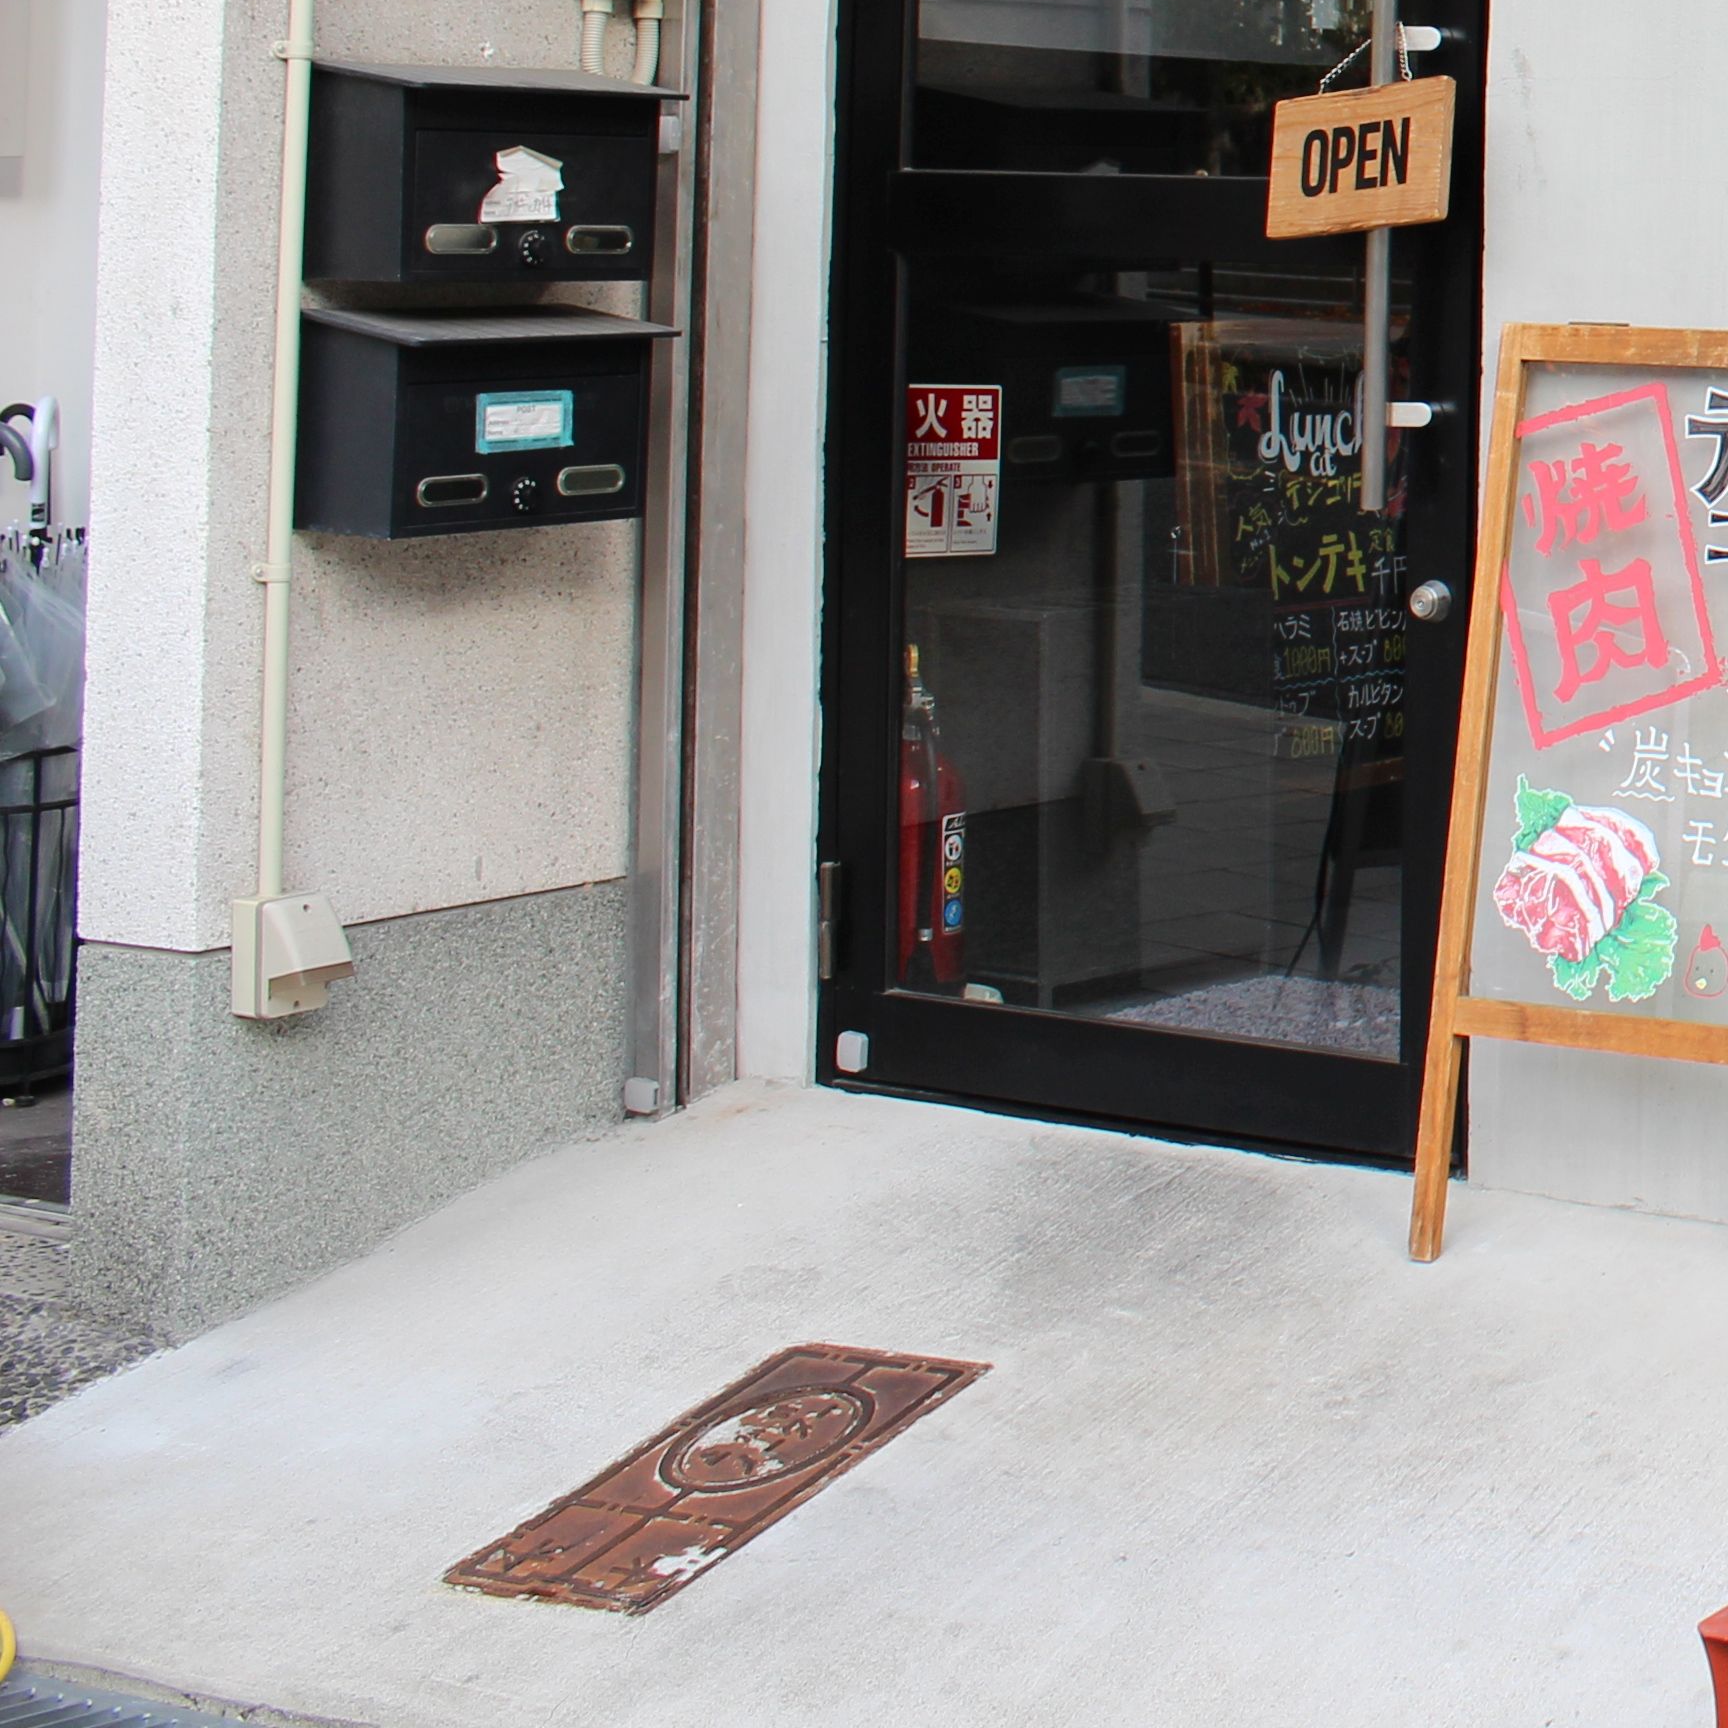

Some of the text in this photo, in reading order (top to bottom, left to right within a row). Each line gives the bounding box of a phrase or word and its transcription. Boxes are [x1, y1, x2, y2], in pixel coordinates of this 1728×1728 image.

[1301, 116, 1412, 198] OPEN
[907, 441, 979, 457] EXTINGUISHER
[914, 393, 994, 439] 火器
[1268, 530, 1366, 600] トンテキ
[1521, 441, 1671, 704] 焼肉
